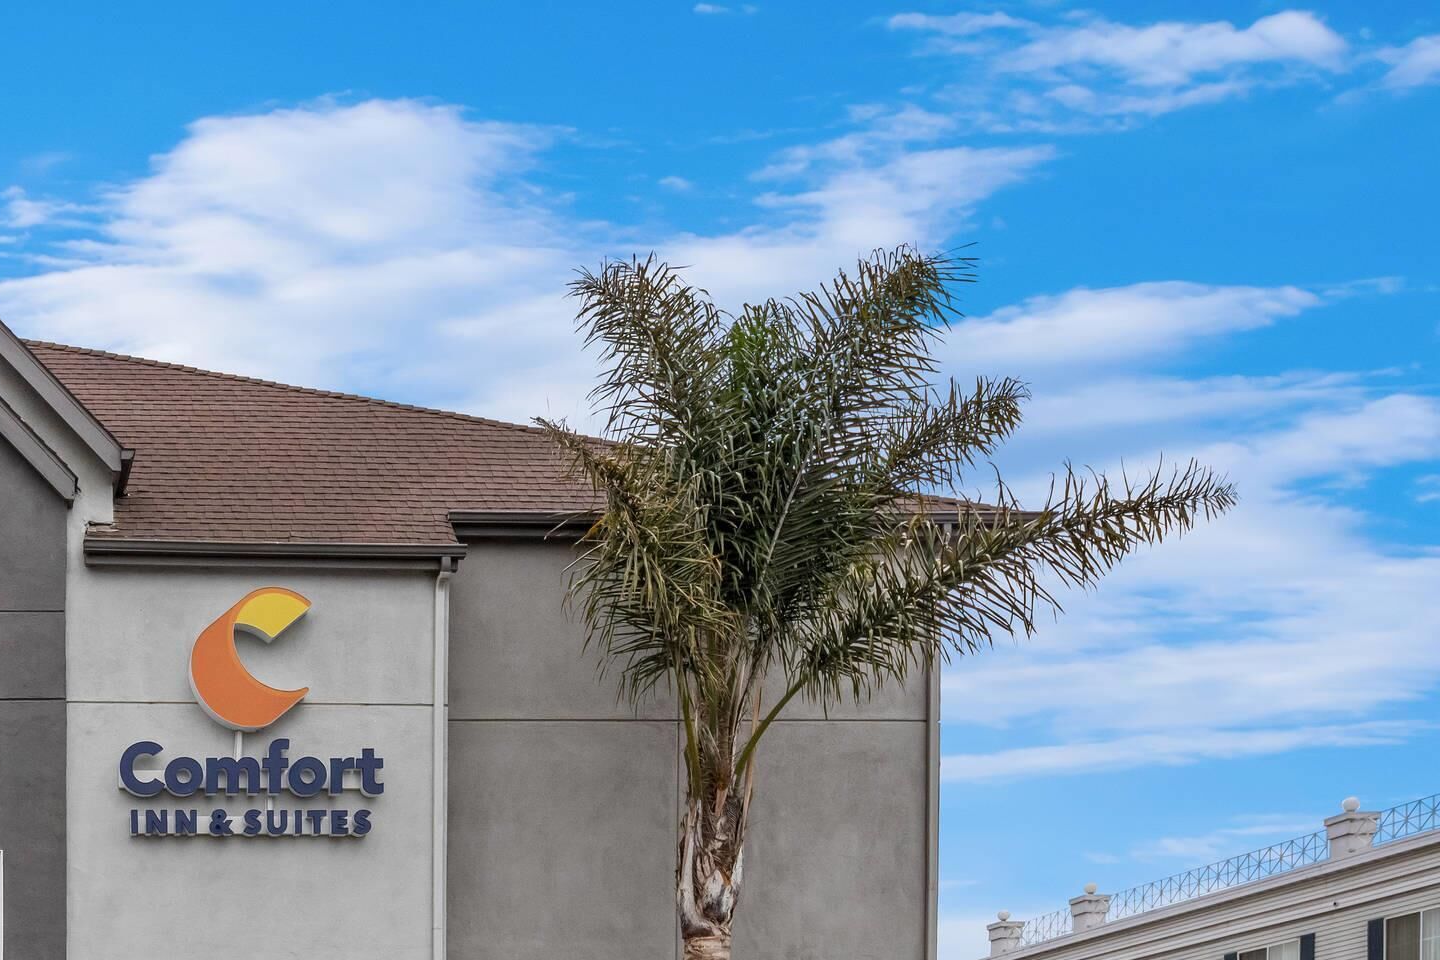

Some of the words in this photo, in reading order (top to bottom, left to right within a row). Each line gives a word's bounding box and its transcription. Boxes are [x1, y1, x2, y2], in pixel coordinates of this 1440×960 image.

[119, 738, 385, 796] Comfort
[130, 809, 198, 835] INN
[209, 808, 234, 835] &
[243, 808, 373, 835] SUITES
